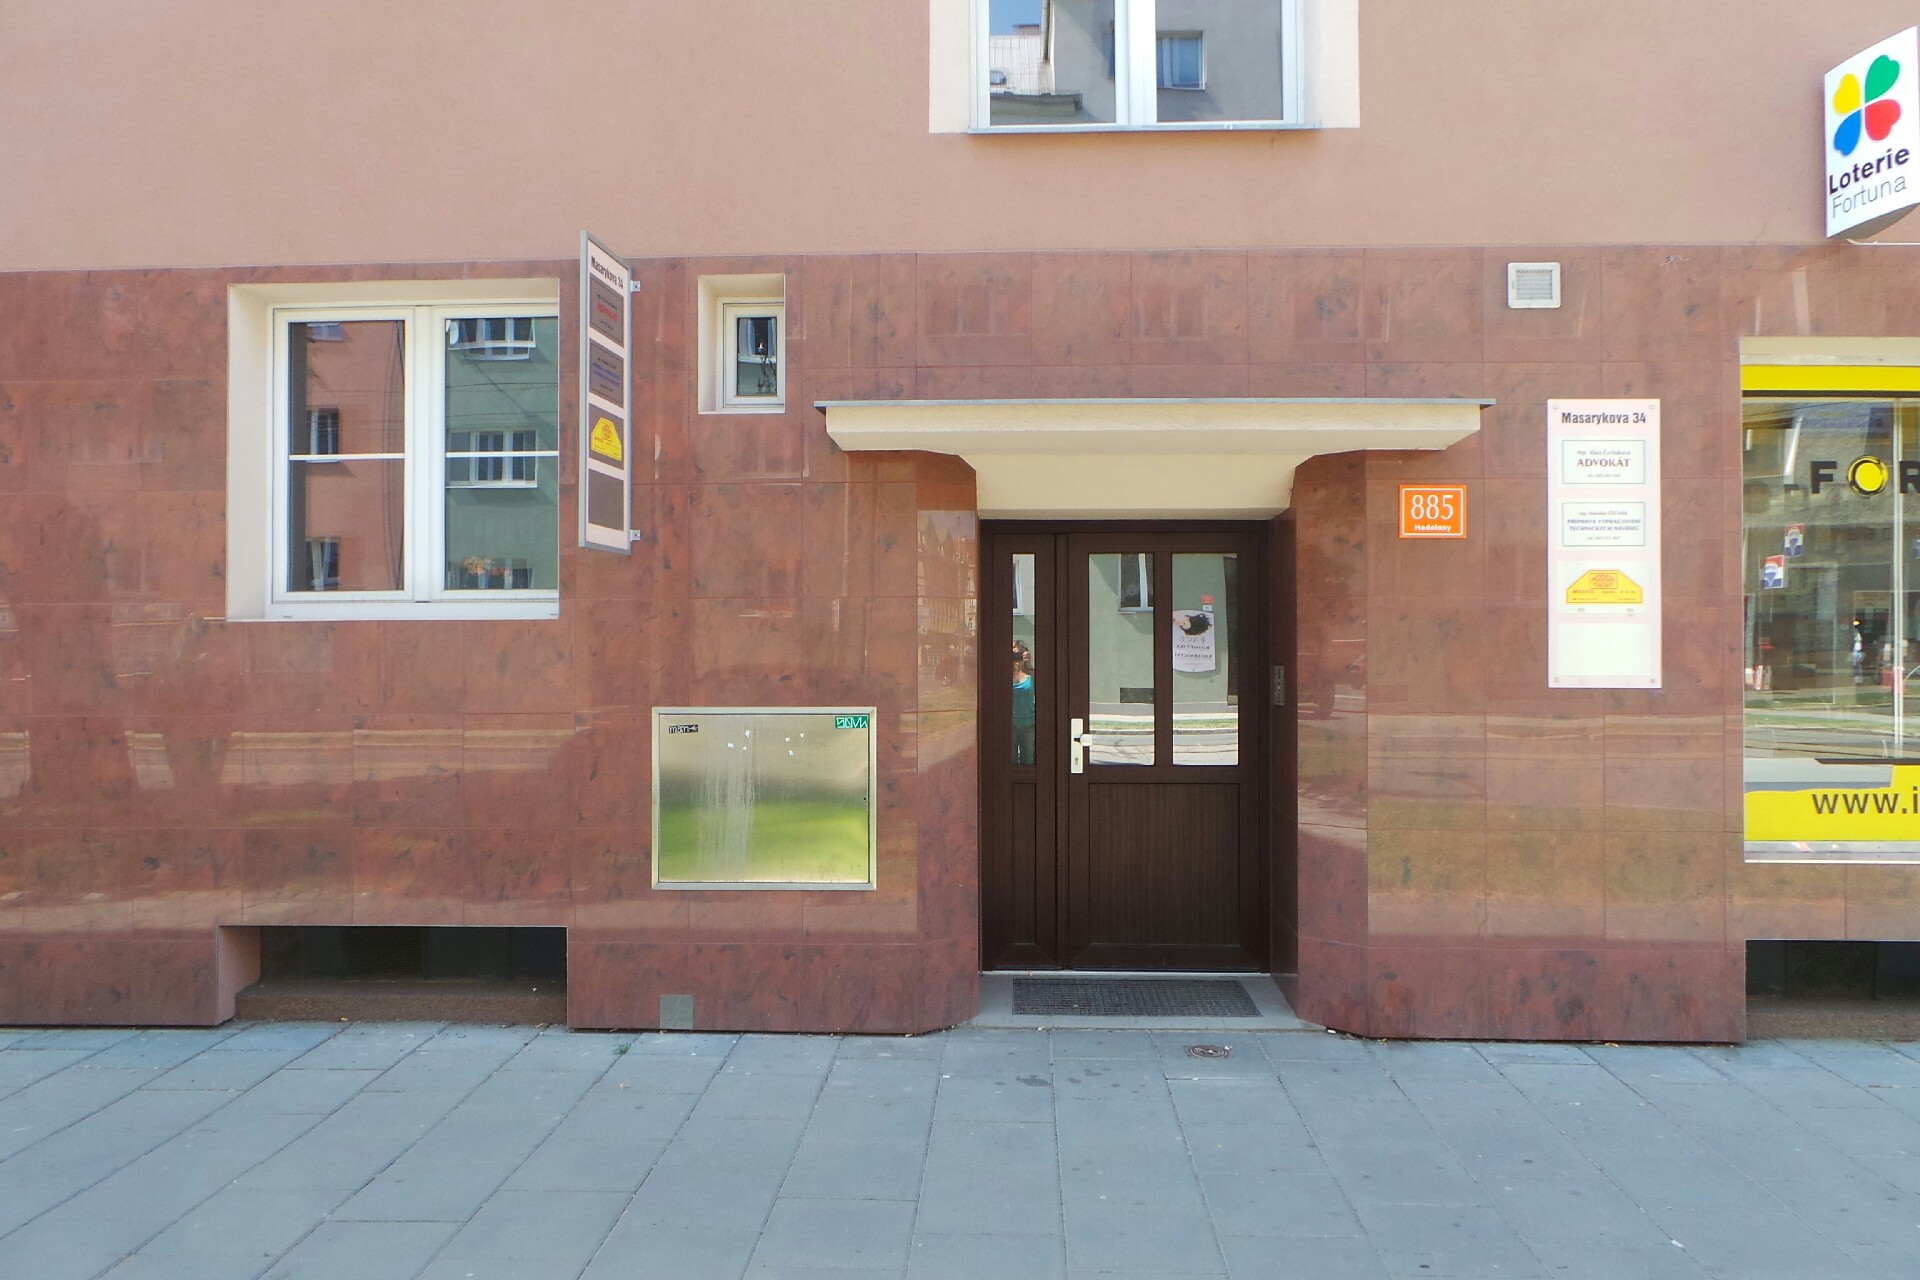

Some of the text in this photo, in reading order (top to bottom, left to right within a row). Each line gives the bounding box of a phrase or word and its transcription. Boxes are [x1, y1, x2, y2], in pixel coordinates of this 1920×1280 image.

[1828, 148, 1910, 195] Loterie
[1832, 175, 1907, 218] Fortuna
[591, 255, 624, 290] Masarykova 34
[1561, 412, 1646, 425] Masarykova 34
[1577, 456, 1631, 467] ADVOKÁT
[1411, 494, 1454, 520] 885
[1414, 524, 1452, 532] Hodolany
[1811, 786, 1919, 814] www.i
